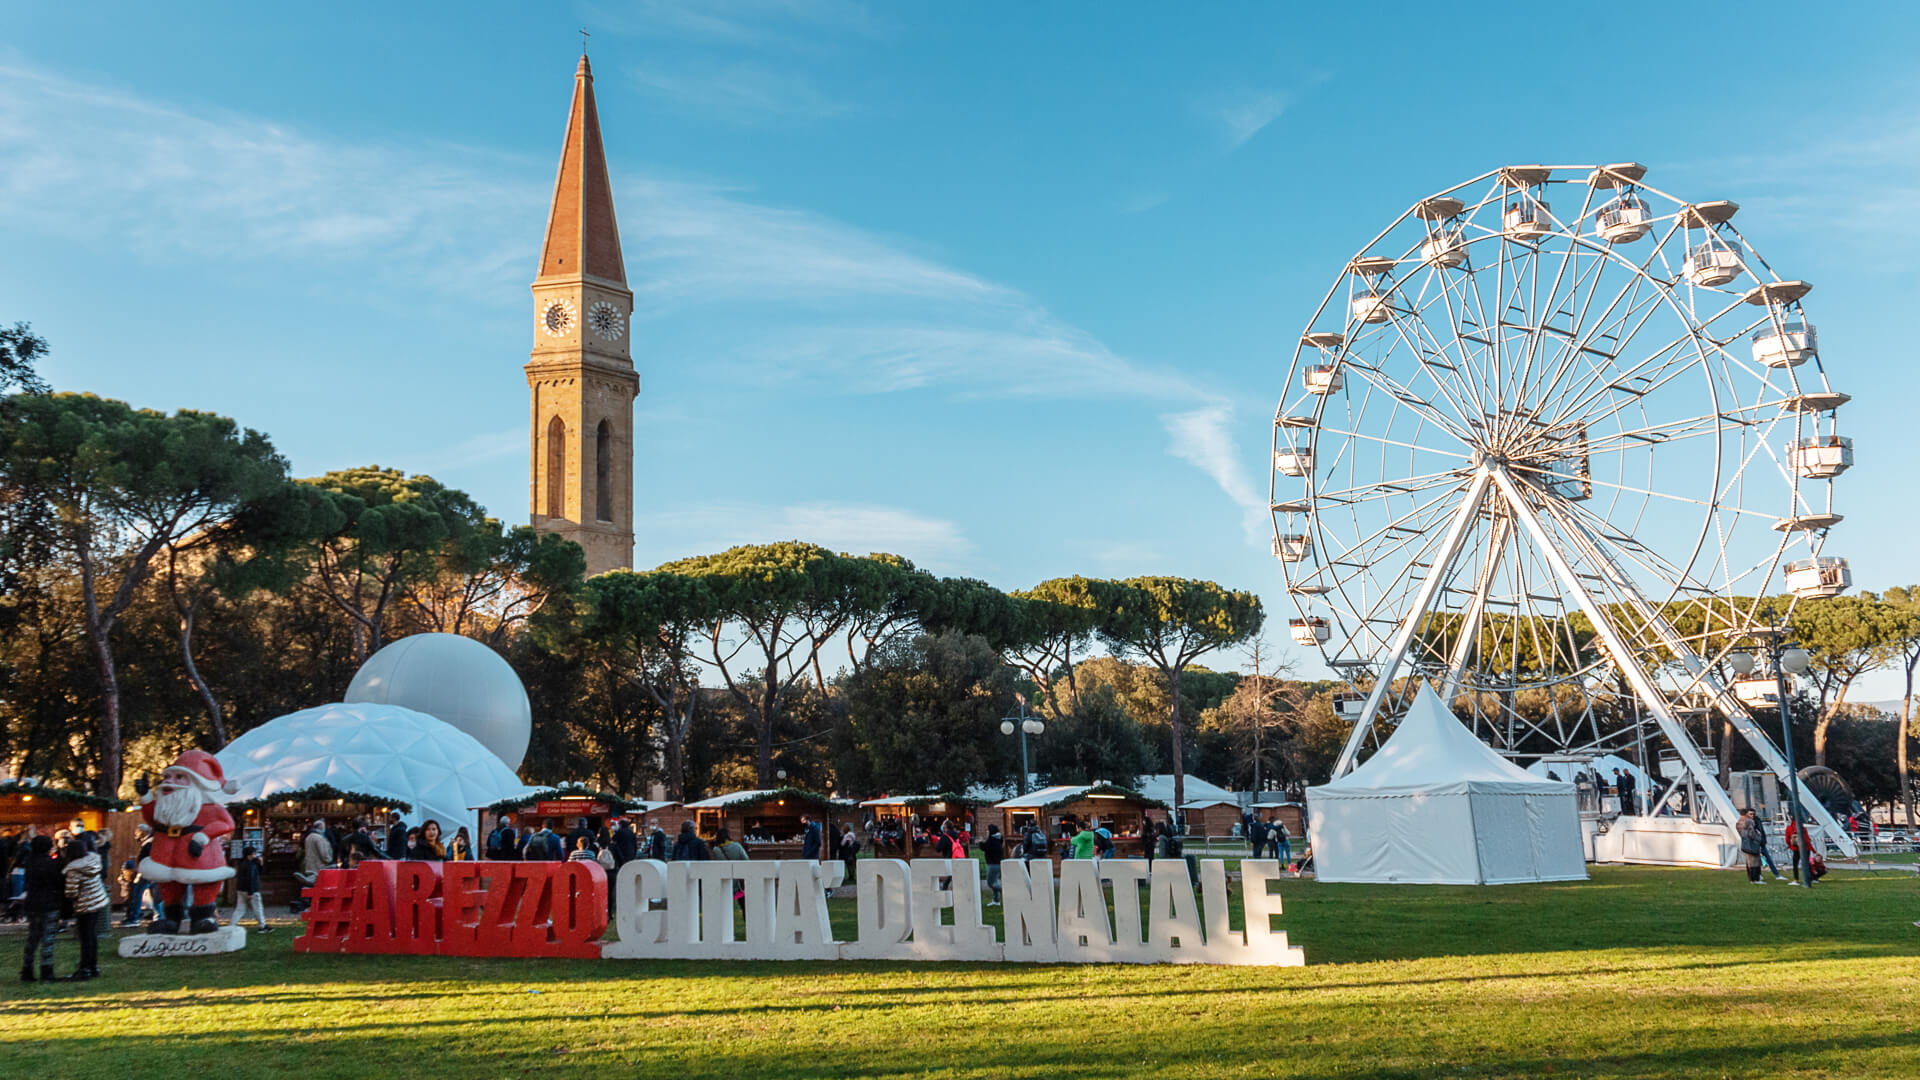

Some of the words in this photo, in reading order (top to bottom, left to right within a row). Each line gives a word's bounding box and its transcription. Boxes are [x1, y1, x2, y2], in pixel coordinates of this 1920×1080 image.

[296, 860, 608, 955] #AREZZO
[612, 859, 846, 952] CITTA'
[856, 858, 997, 952] DEL
[1000, 858, 1294, 958] NATALE
